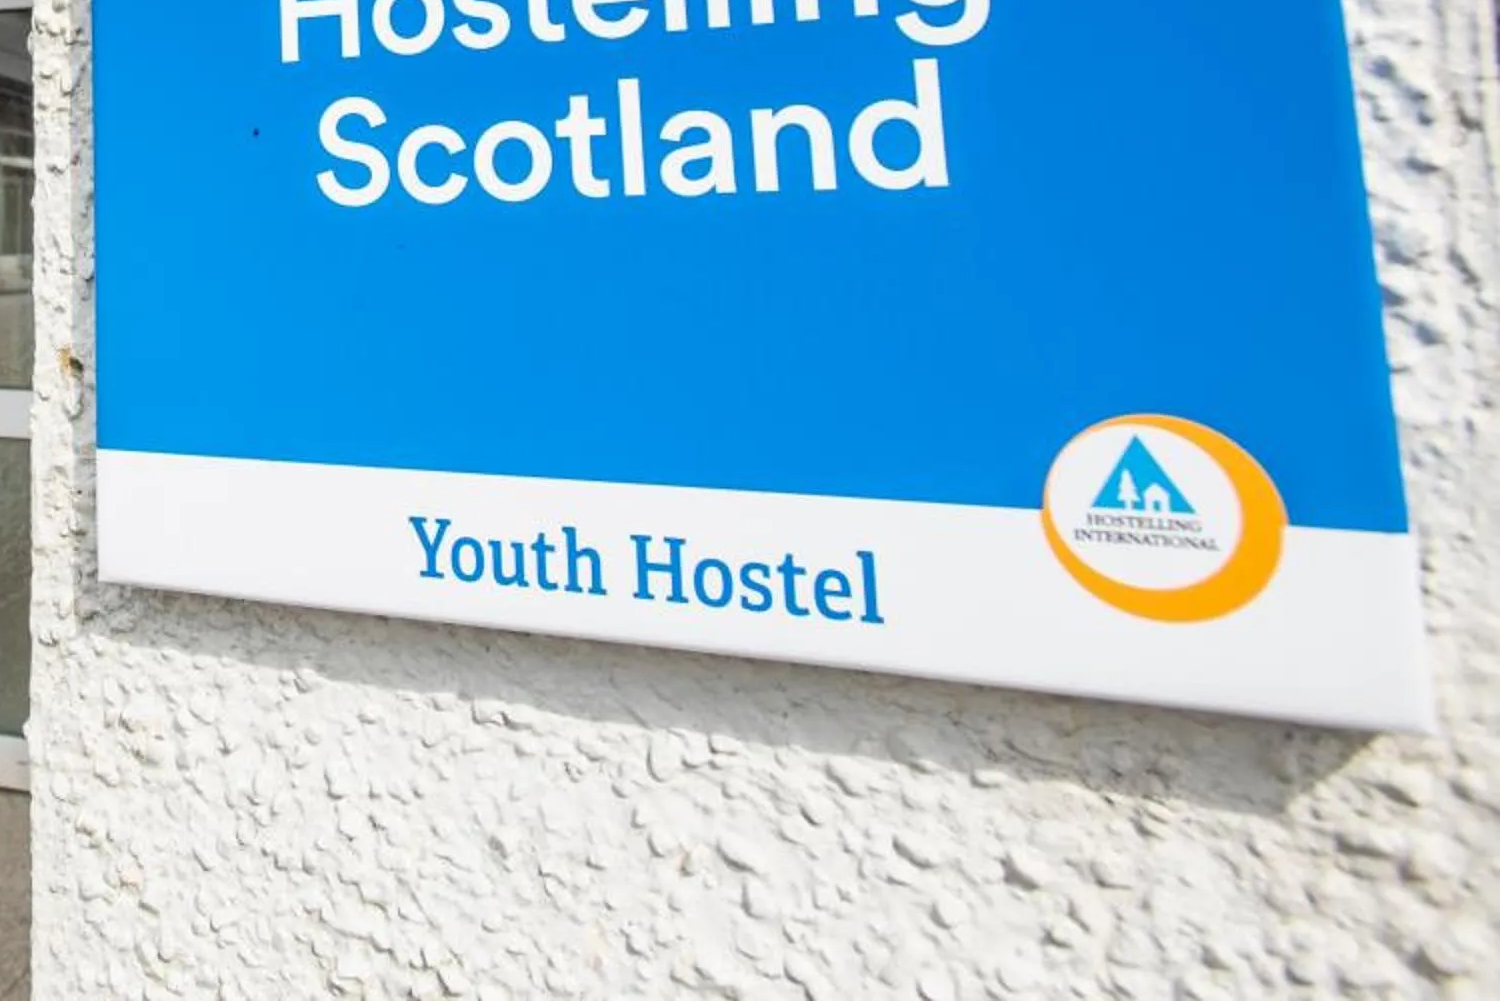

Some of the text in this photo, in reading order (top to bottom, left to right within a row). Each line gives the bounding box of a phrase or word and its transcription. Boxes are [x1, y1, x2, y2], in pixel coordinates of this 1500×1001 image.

[316, 58, 950, 207] Scotland
[1074, 528, 1221, 551] INTERNATIONAL
[1086, 513, 1202, 533] HOSTELLING
[408, 516, 886, 625] Youth Hostel
